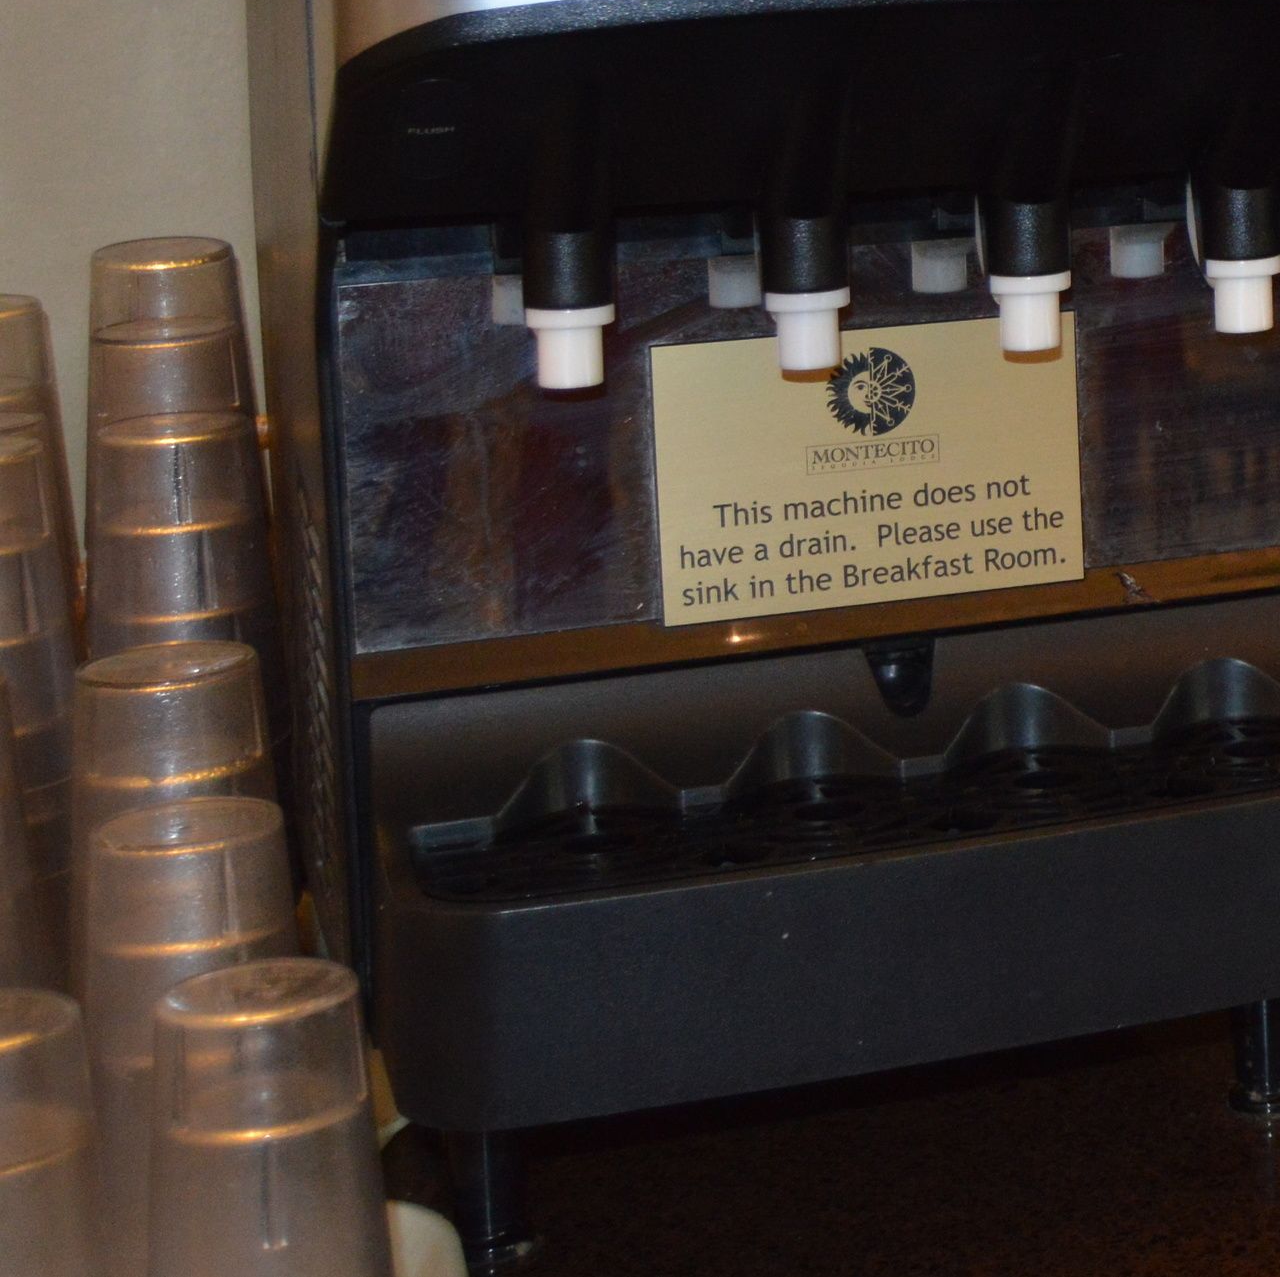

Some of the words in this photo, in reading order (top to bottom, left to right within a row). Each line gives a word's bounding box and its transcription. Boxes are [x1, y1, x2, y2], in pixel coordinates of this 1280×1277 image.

[812, 439, 935, 464] MONTECITO
[713, 501, 773, 529] This
[784, 488, 902, 521] machine
[913, 478, 977, 508] does
[985, 474, 1031, 501] not
[680, 543, 744, 570] have
[754, 543, 770, 562] a
[779, 531, 857, 559] drain.
[876, 521, 961, 549] Please
[970, 515, 1013, 538] use
[1022, 506, 1065, 533] the
[682, 576, 740, 607] sink
[749, 574, 775, 600] in
[785, 568, 833, 594] the
[843, 549, 974, 589] Breakfast
[984, 543, 1067, 572] Room.
